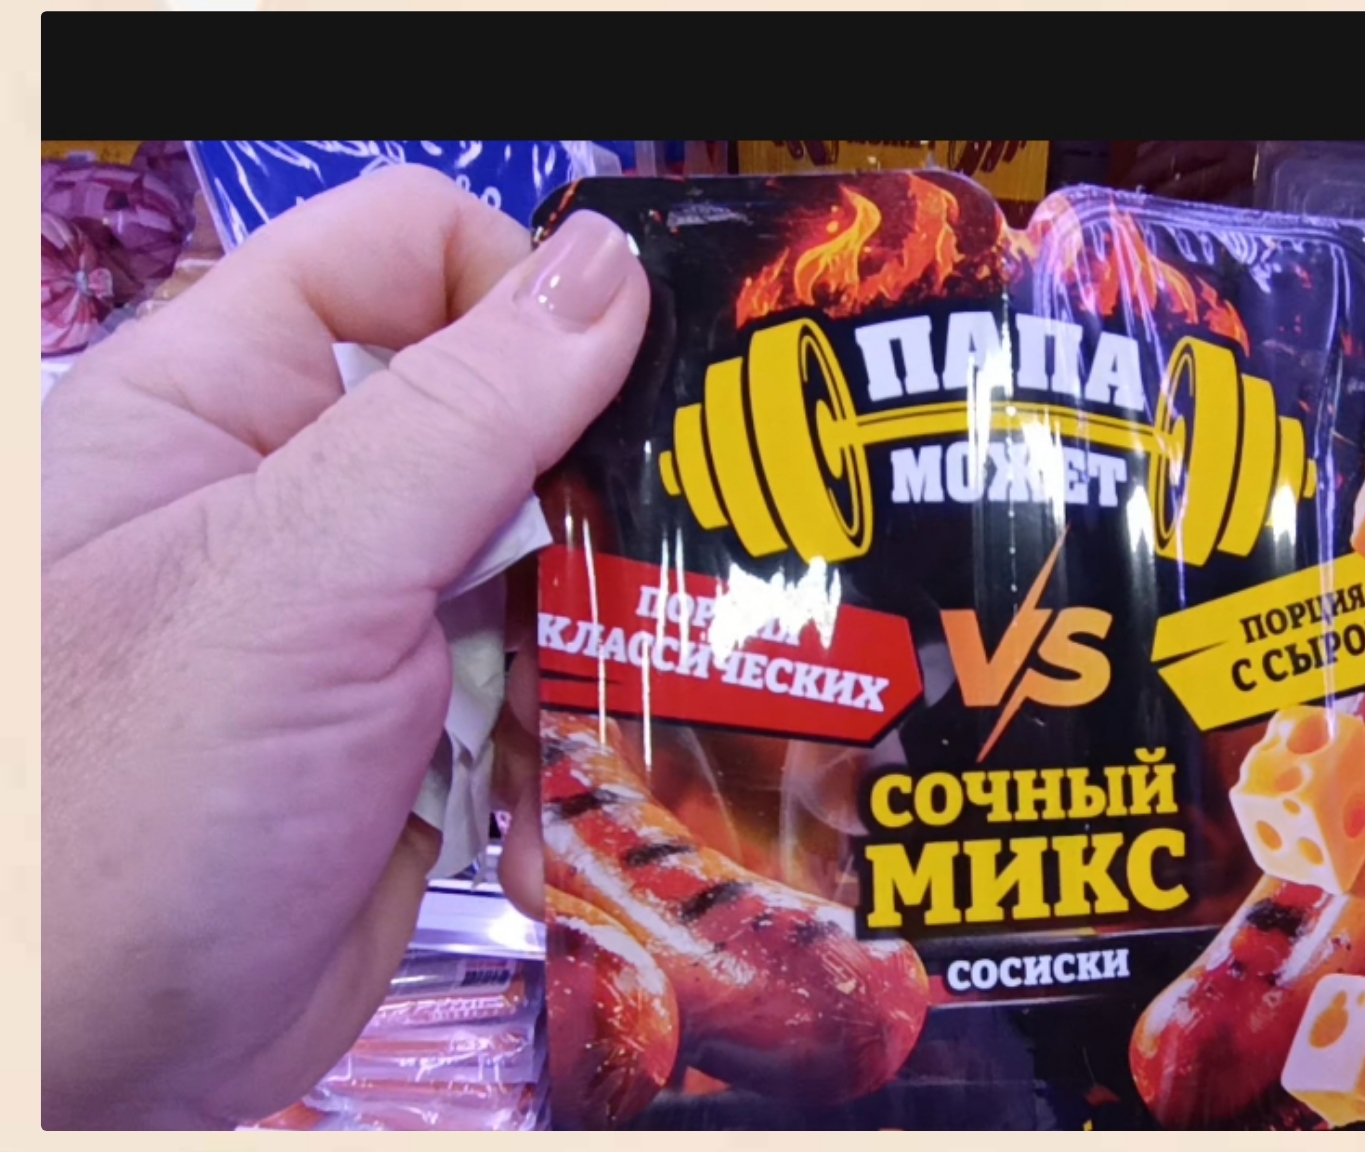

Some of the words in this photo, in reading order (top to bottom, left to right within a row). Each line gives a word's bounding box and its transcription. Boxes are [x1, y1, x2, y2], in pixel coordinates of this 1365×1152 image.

[854, 311, 1146, 411] ПАПА
[890, 440, 1127, 507] МОЖЕТ
[537, 612, 889, 712] КЛАССИЧЕСКИХ
[940, 605, 1113, 708] VS
[1231, 658, 1258, 692] С
[870, 747, 1179, 827] СОЧНЫЙ
[865, 828, 1190, 928] МИКС
[947, 948, 1130, 991] СОСИСКИ
